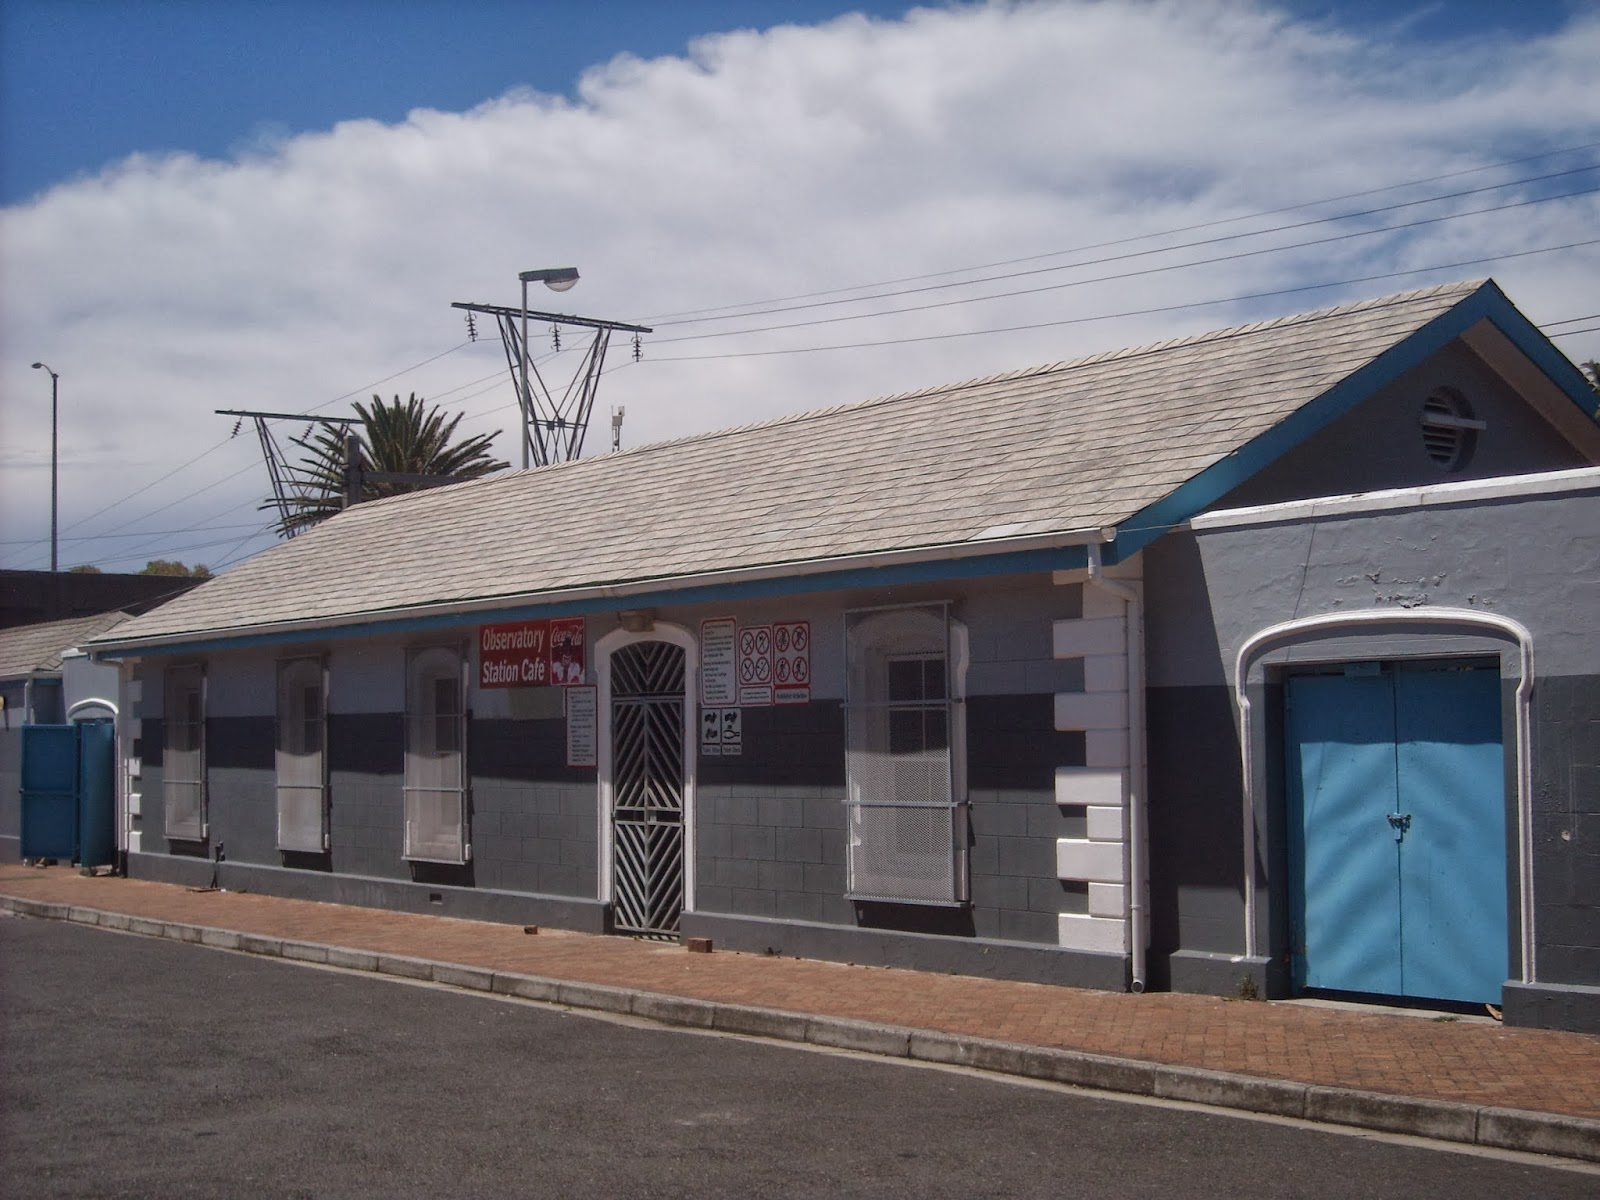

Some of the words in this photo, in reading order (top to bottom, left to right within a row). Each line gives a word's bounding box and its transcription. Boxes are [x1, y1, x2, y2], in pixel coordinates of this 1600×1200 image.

[482, 627, 545, 653] Observatory
[482, 659, 519, 684] Station
[521, 657, 545, 681] Cafe
